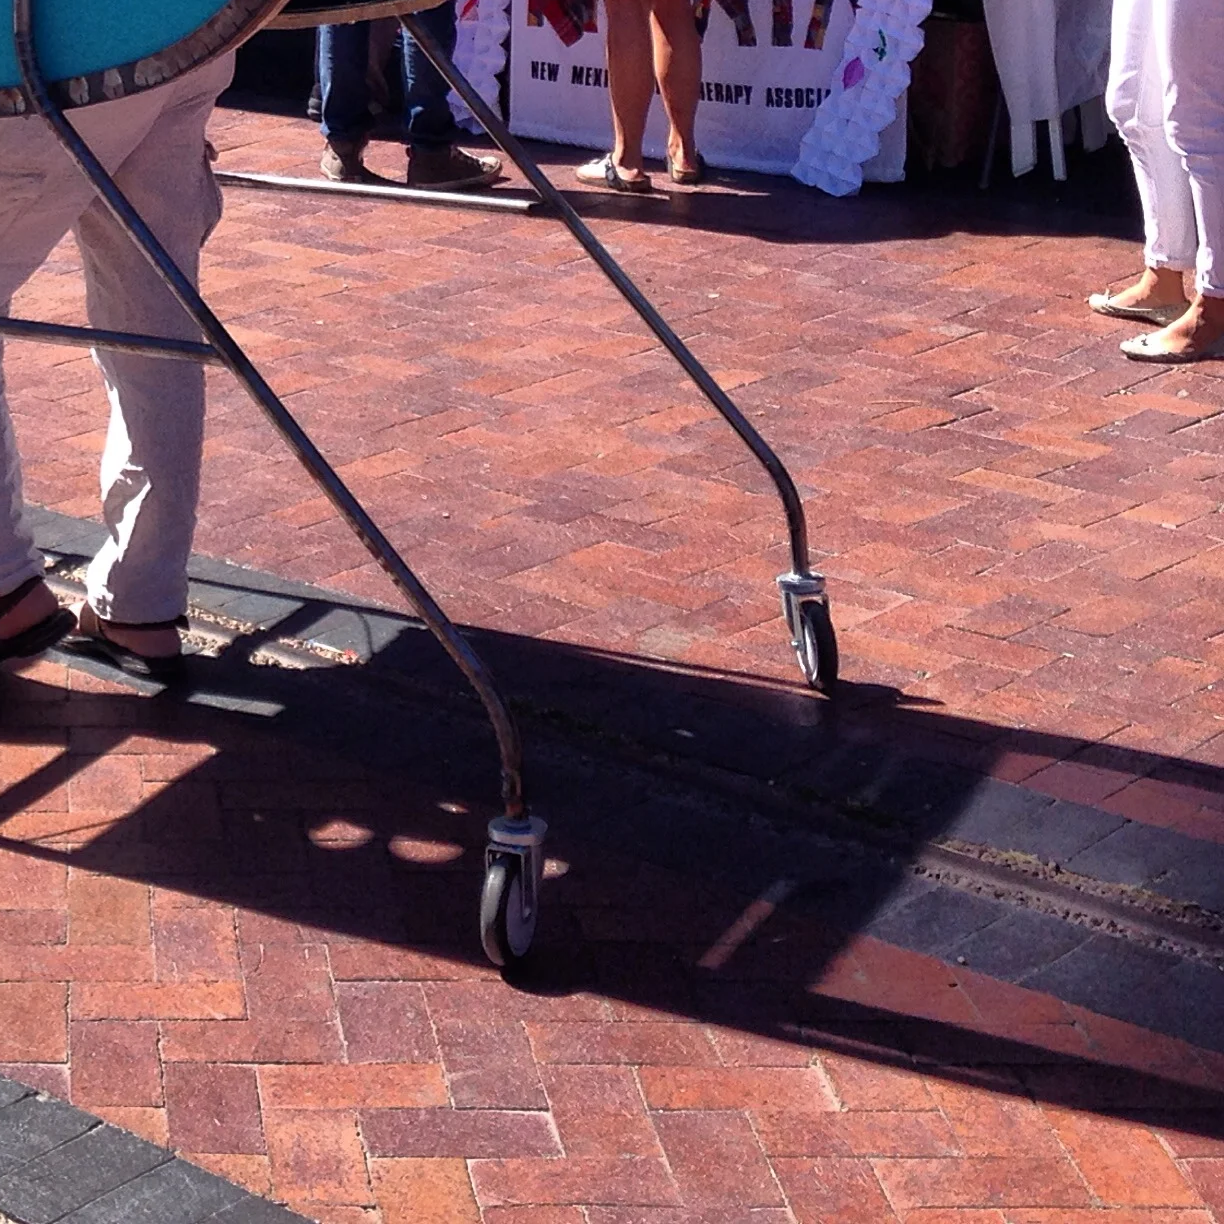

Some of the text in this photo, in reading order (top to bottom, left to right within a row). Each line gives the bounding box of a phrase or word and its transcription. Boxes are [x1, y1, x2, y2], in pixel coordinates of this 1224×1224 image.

[531, 61, 831, 108] NEW MEXI HERAPY ASSOCI
